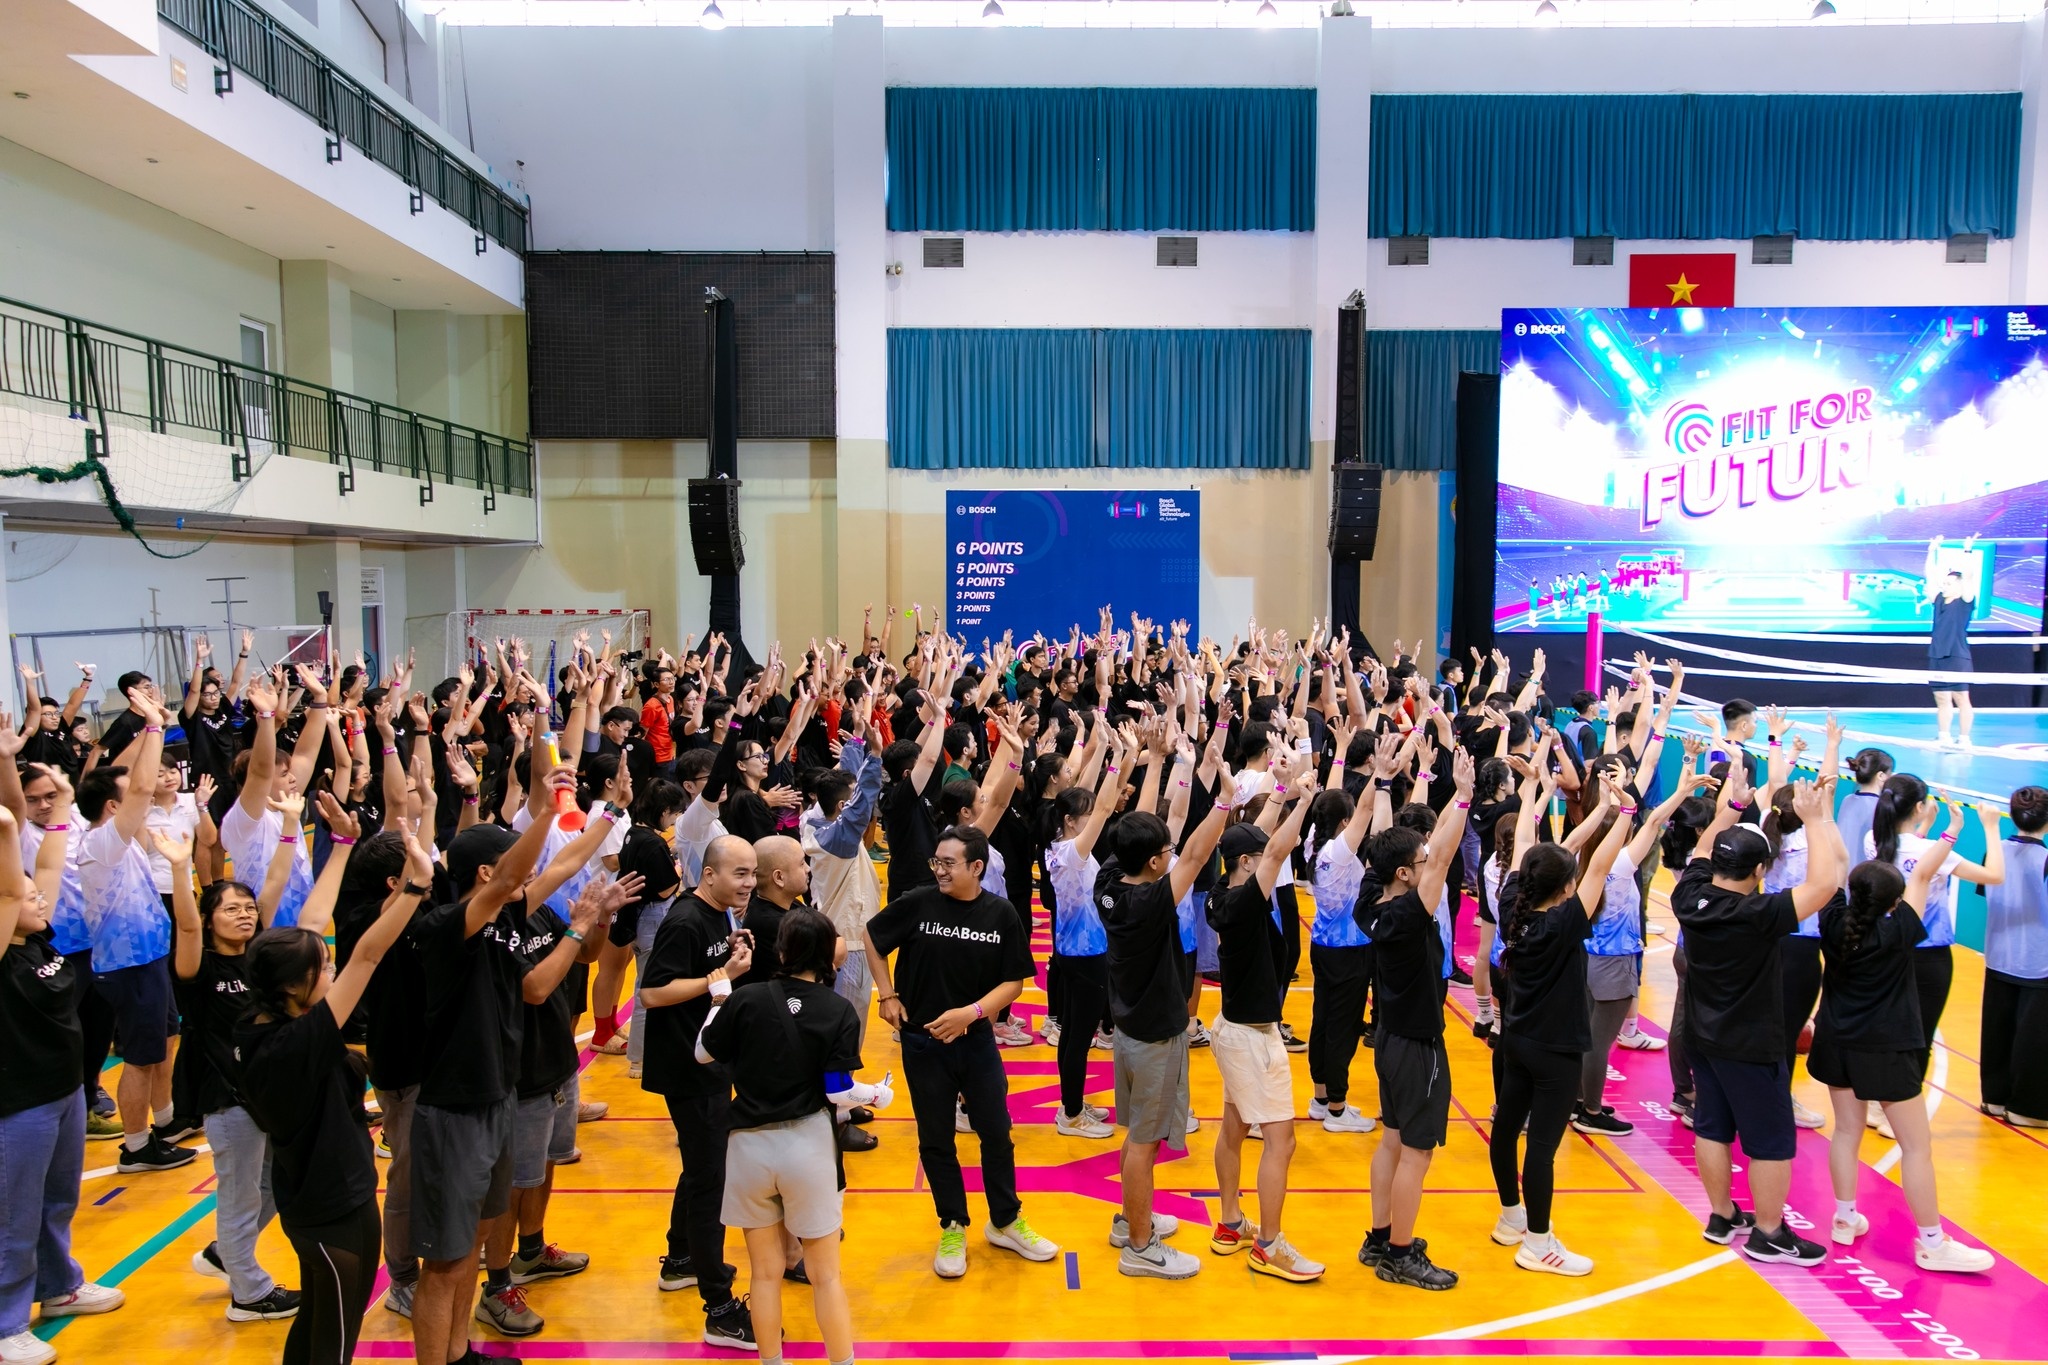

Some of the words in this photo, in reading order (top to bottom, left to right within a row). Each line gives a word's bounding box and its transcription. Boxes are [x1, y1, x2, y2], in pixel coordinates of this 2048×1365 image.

[1530, 324, 1566, 334] BOSCH
[1722, 405, 1777, 447] FIT
[1790, 387, 1873, 435] FOR
[1641, 428, 1874, 531] FUTUR
[968, 506, 996, 514] BOSCH
[956, 542, 966, 555] 6
[968, 541, 1024, 555] POINTS
[956, 563, 965, 574] 5
[967, 562, 1015, 574] POINTS
[956, 577, 964, 587] 4
[966, 577, 1006, 587] POINTS
[956, 591, 963, 600] 3
[963, 591, 996, 600] POINTS
[919, 921, 1001, 944] #LikeABosch
[1638, 1101, 1678, 1121] 950
[1833, 1255, 1904, 1300] 1100
[1900, 1308, 1981, 1360] 1200
